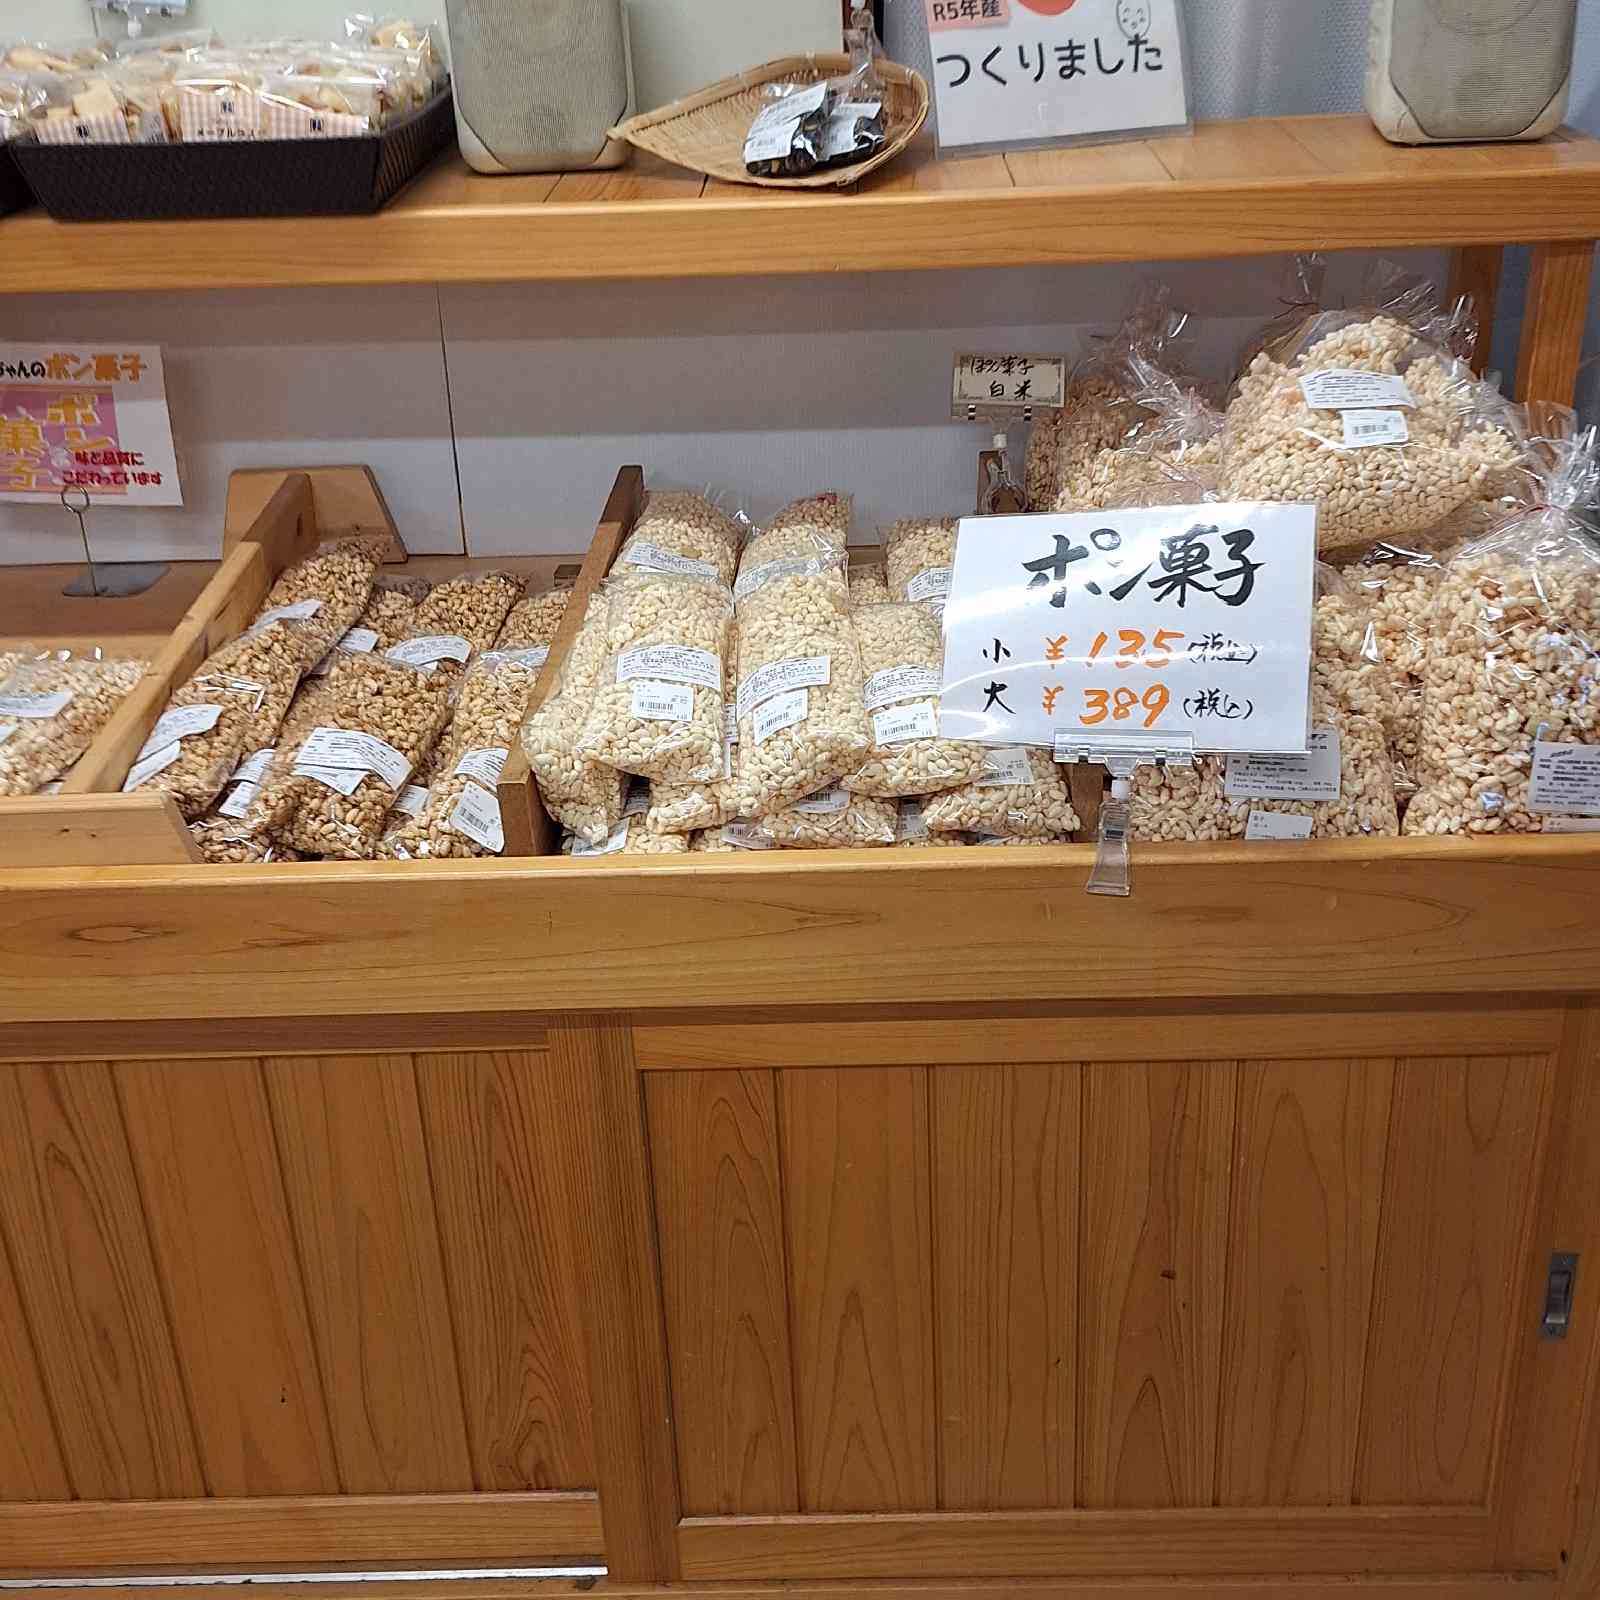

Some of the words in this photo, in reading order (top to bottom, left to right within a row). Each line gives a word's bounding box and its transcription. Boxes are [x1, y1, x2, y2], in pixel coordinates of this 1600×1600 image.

[936, 33, 1163, 88] つくりました
[1022, 522, 1267, 608] ポン菓子
[983, 638, 1011, 664] 小
[984, 681, 1016, 715] 大
